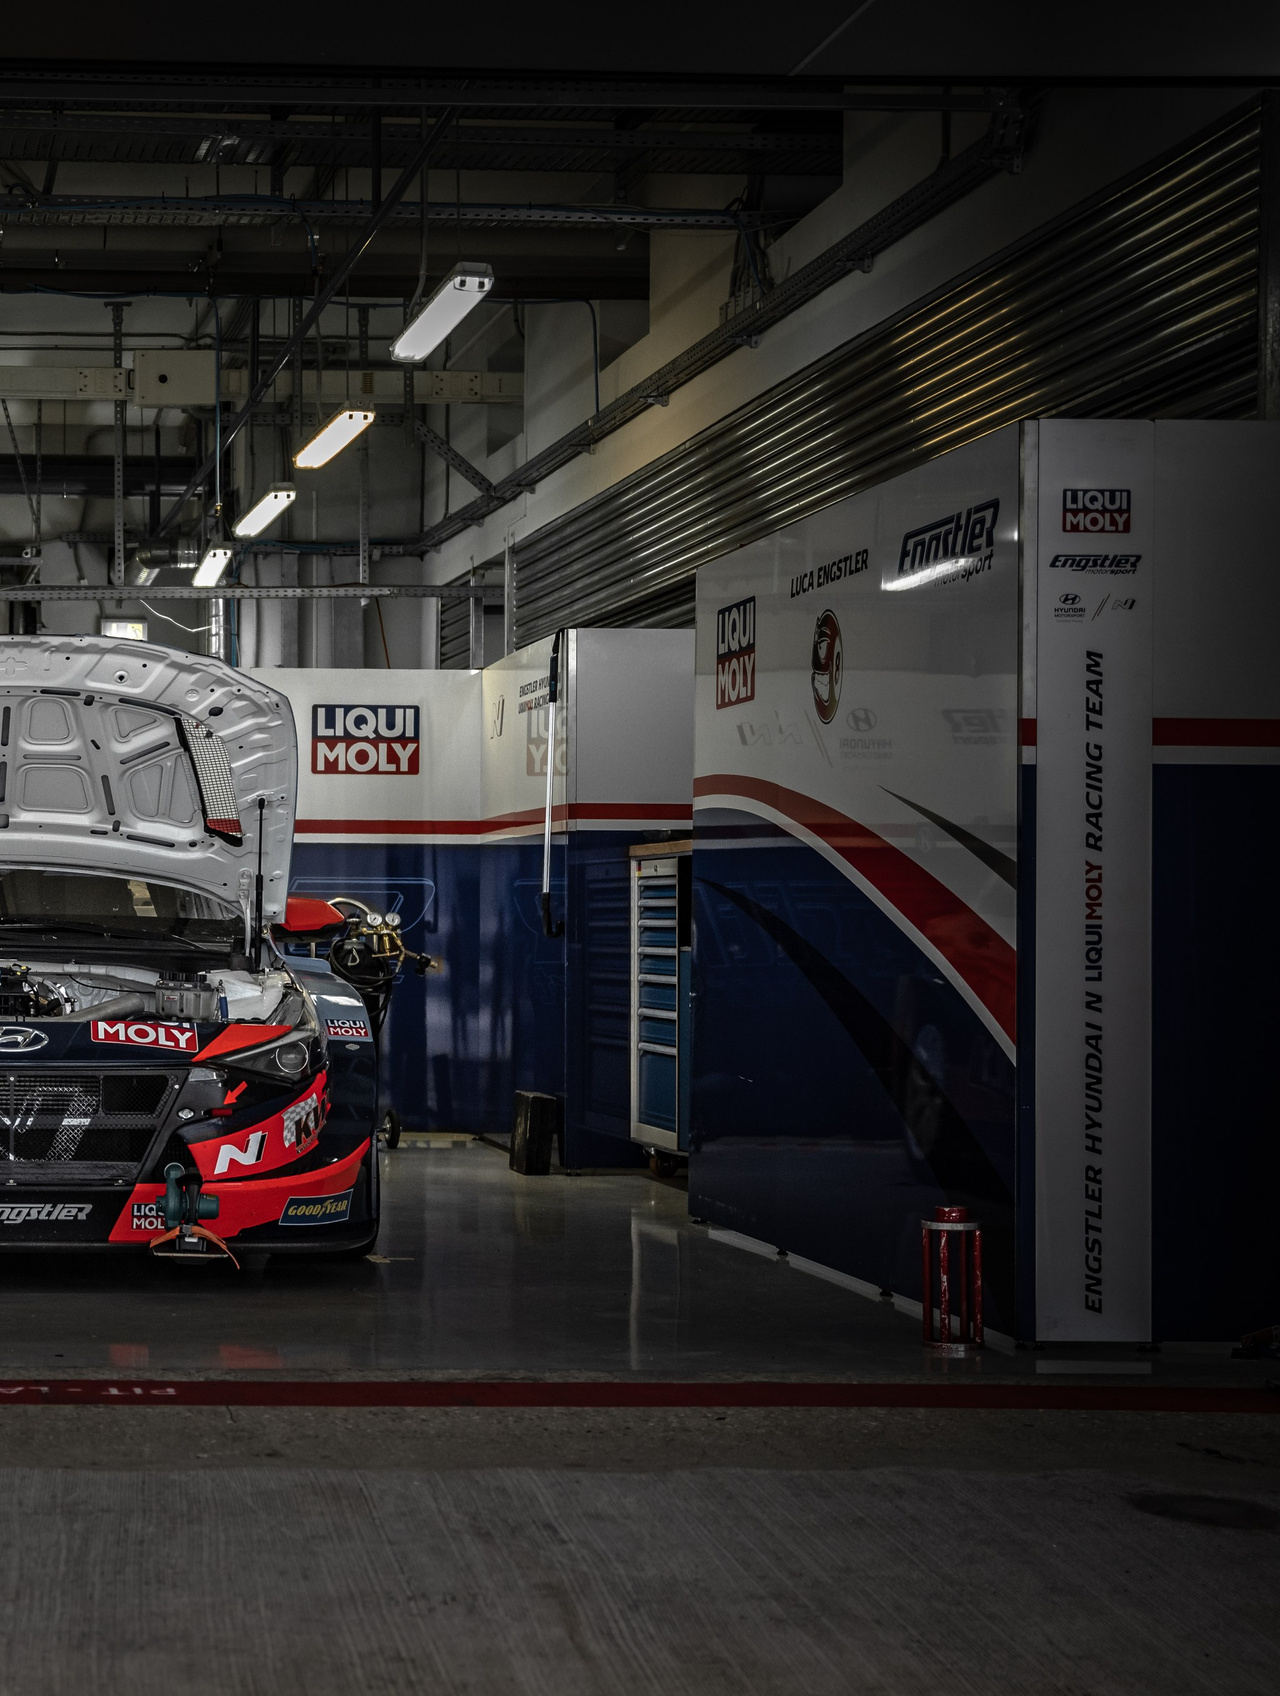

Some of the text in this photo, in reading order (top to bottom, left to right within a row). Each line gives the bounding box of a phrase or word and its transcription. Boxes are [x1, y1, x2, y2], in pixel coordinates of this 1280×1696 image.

[1065, 490, 1128, 510] LIQUI
[1065, 512, 1129, 532] MOLY
[790, 548, 868, 598] LUCA ENGSTLER
[718, 601, 755, 655] LIQUI
[718, 652, 755, 705] MOLY
[1086, 651, 1104, 731] TEAM
[316, 707, 416, 739] LIQUI
[316, 741, 418, 773] MOLY
[1085, 743, 1104, 853] RACING
[1085, 992, 1103, 1014] N
[97, 1021, 194, 1048] MOLY
[327, 1019, 366, 1028] LIQUI
[330, 1027, 369, 1037] MOLY
[1085, 1022, 1103, 1156] HYUNDAI
[133, 1204, 166, 1216] LIQ
[287, 1200, 348, 1217] GOODYEAR
[132, 1217, 166, 1230] MOL
[1085, 1165, 1103, 1315] ENGSTLER
